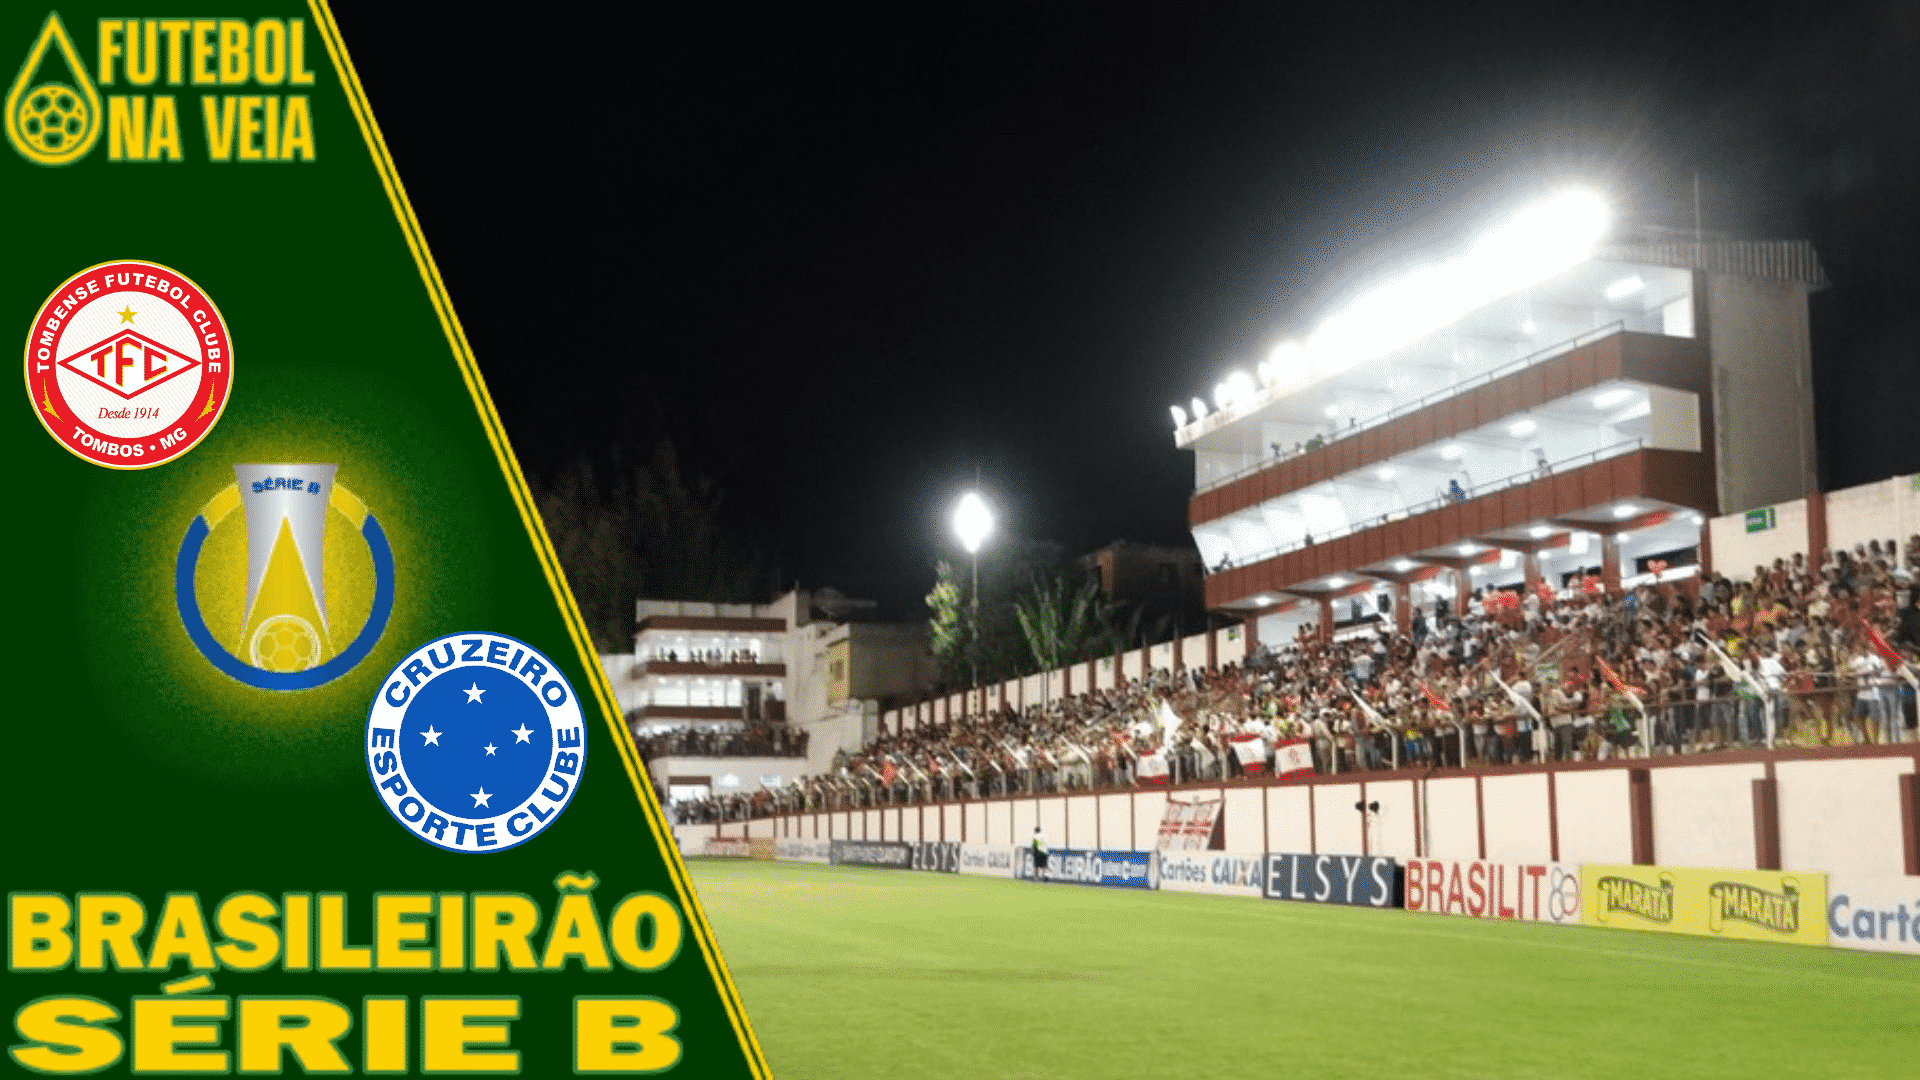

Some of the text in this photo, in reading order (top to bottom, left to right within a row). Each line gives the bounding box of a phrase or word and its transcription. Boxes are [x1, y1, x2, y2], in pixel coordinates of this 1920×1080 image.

[1024, 851, 1101, 882] BSILEIRÃO
[1160, 856, 1206, 882] Cartões
[1211, 857, 1263, 888] CAIXA
[1267, 854, 1388, 906] ELSYS
[1407, 860, 1547, 921] BRASILIT
